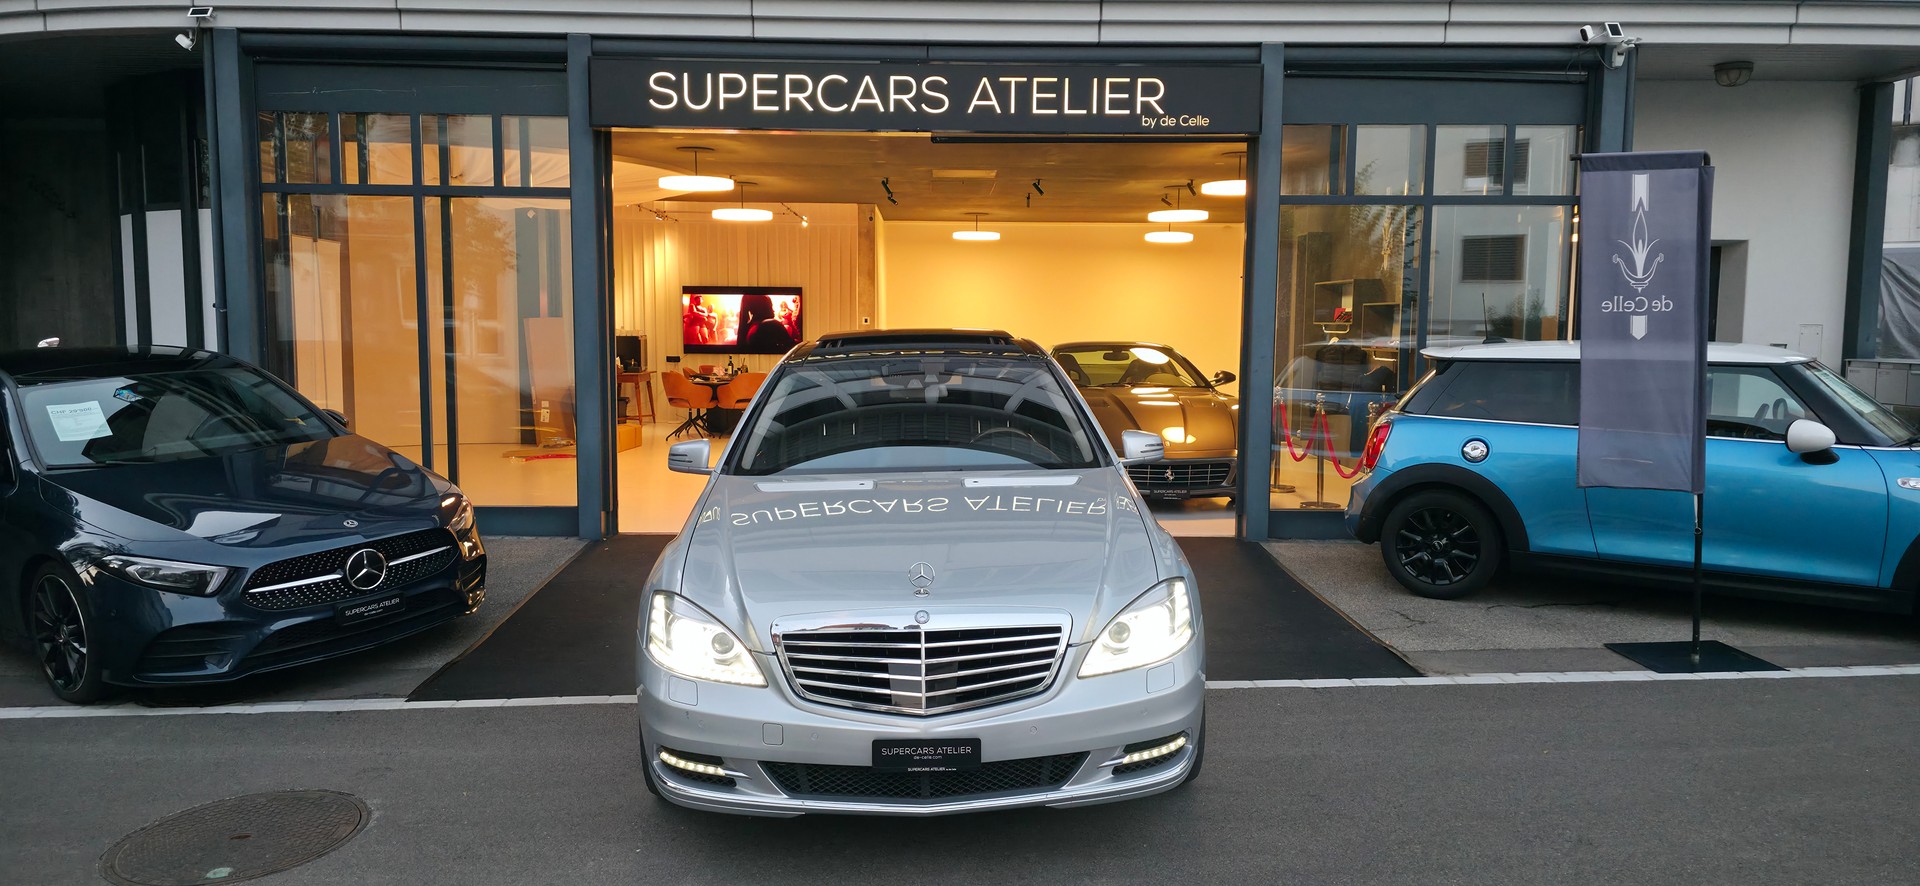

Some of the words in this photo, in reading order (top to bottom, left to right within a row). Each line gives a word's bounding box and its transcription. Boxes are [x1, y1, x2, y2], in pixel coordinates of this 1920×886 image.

[647, 71, 950, 113] SUPERCARS
[967, 76, 1166, 115] ATELIER
[1141, 114, 1158, 129] by
[1160, 114, 1177, 127] de
[1179, 114, 1210, 127] Celle
[345, 603, 379, 616] SUPERCARS
[379, 597, 400, 608] ATELIER
[881, 747, 935, 755] SUPERCARS
[936, 746, 972, 755] ATELIER
